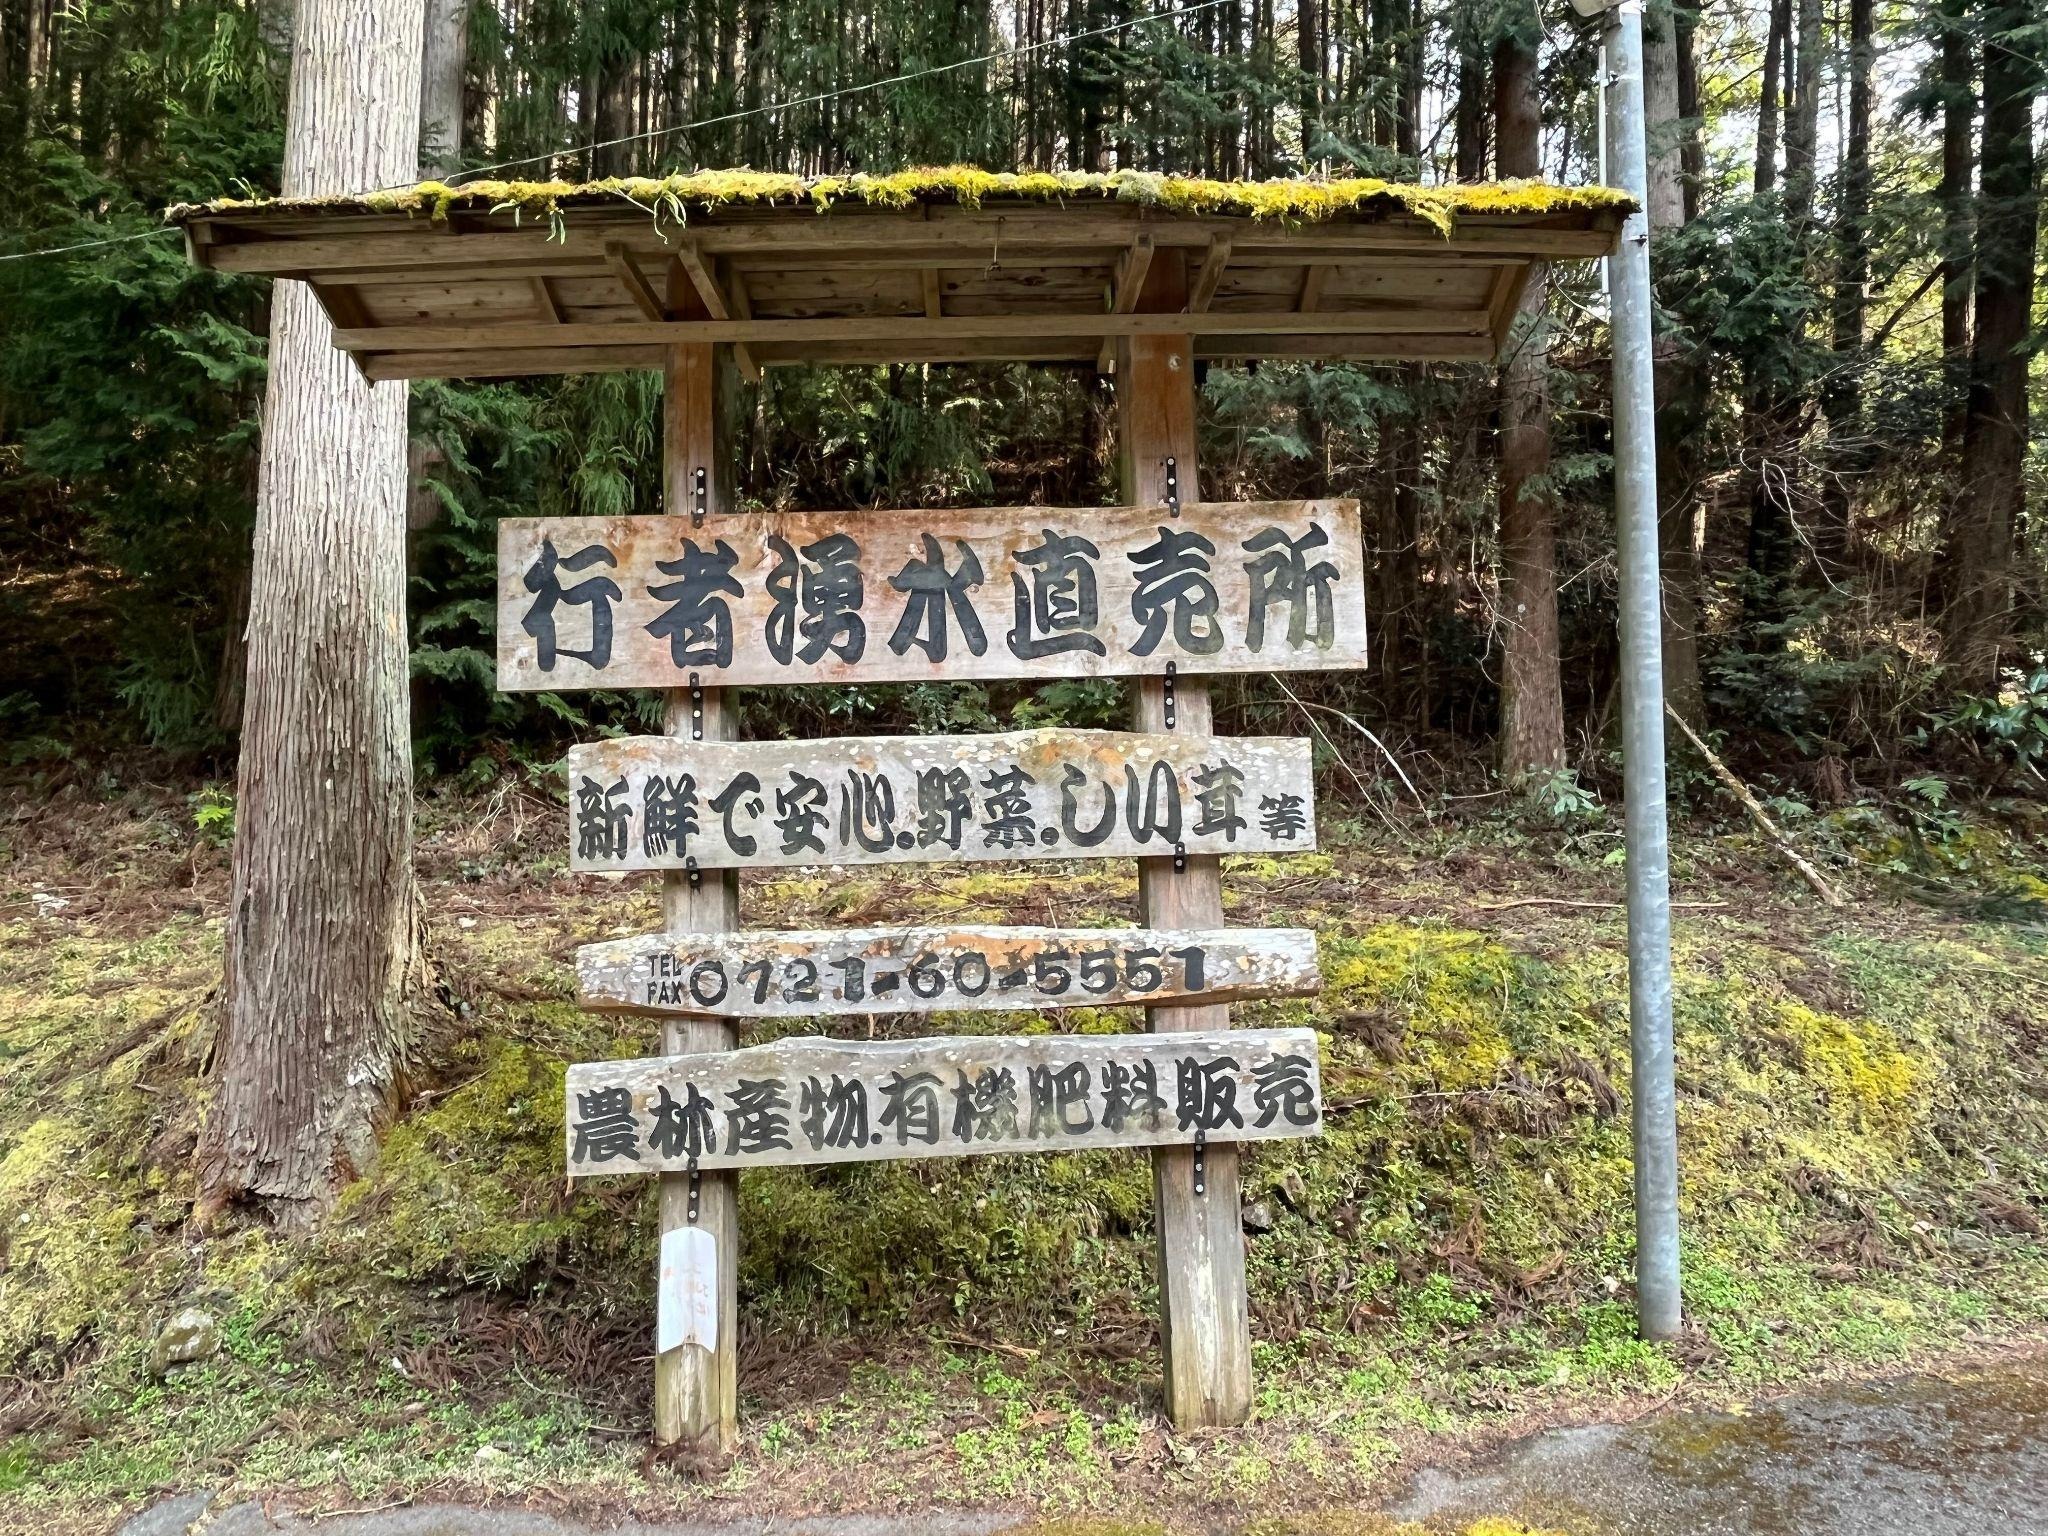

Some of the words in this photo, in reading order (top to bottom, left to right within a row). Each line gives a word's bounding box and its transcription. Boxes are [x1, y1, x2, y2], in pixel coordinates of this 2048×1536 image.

[521, 521, 1341, 673] 行者湧水直売所
[648, 953, 682, 978] TEL
[689, 946, 1206, 1007] 0721-60-5551
[647, 981, 683, 1005] FAX
